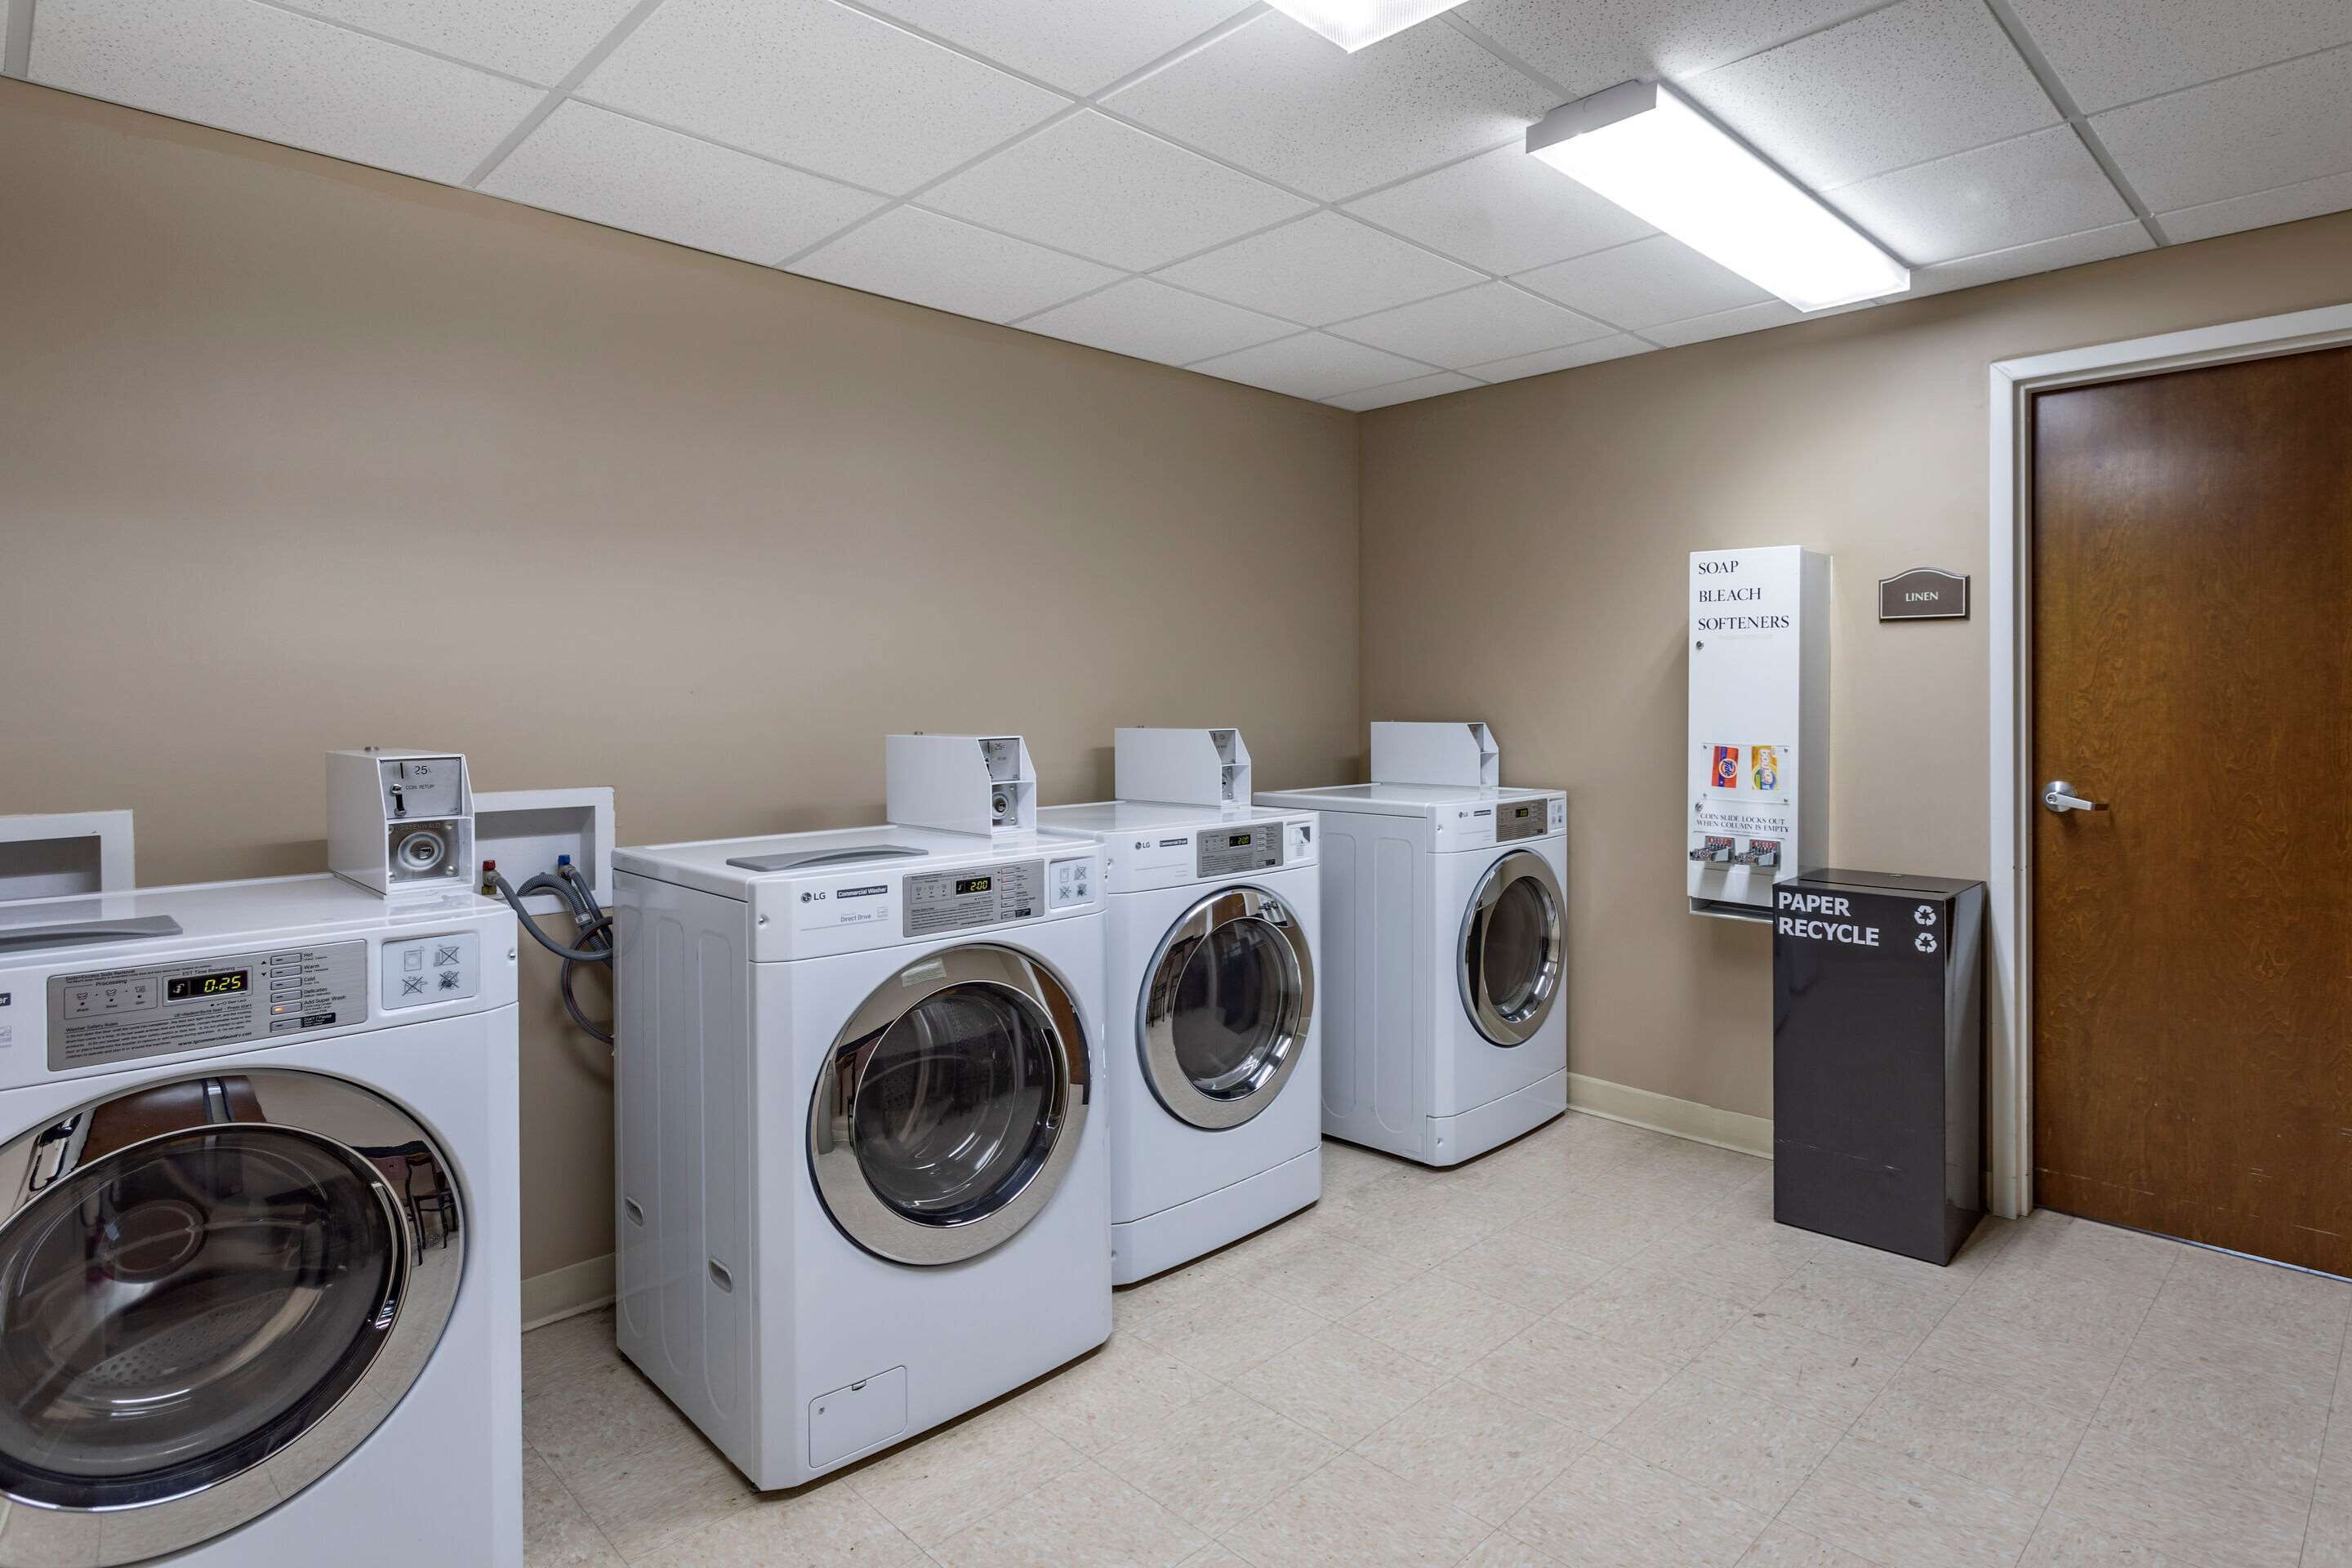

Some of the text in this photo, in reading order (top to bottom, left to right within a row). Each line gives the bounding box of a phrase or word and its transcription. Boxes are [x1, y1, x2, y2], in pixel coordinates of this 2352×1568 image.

[1699, 560, 1739, 575] SOAP
[1699, 587, 1762, 603] BLEACH
[1905, 591, 1939, 602] LINEN
[1698, 615, 1789, 630] SOFTENERS
[1723, 760, 1733, 777] Tide
[1721, 822, 1753, 830] COLUMN
[813, 892, 826, 901] LG
[838, 889, 866, 898] Commercial
[1779, 892, 1851, 916] PAPER
[1779, 917, 1879, 947] RECYCLE
